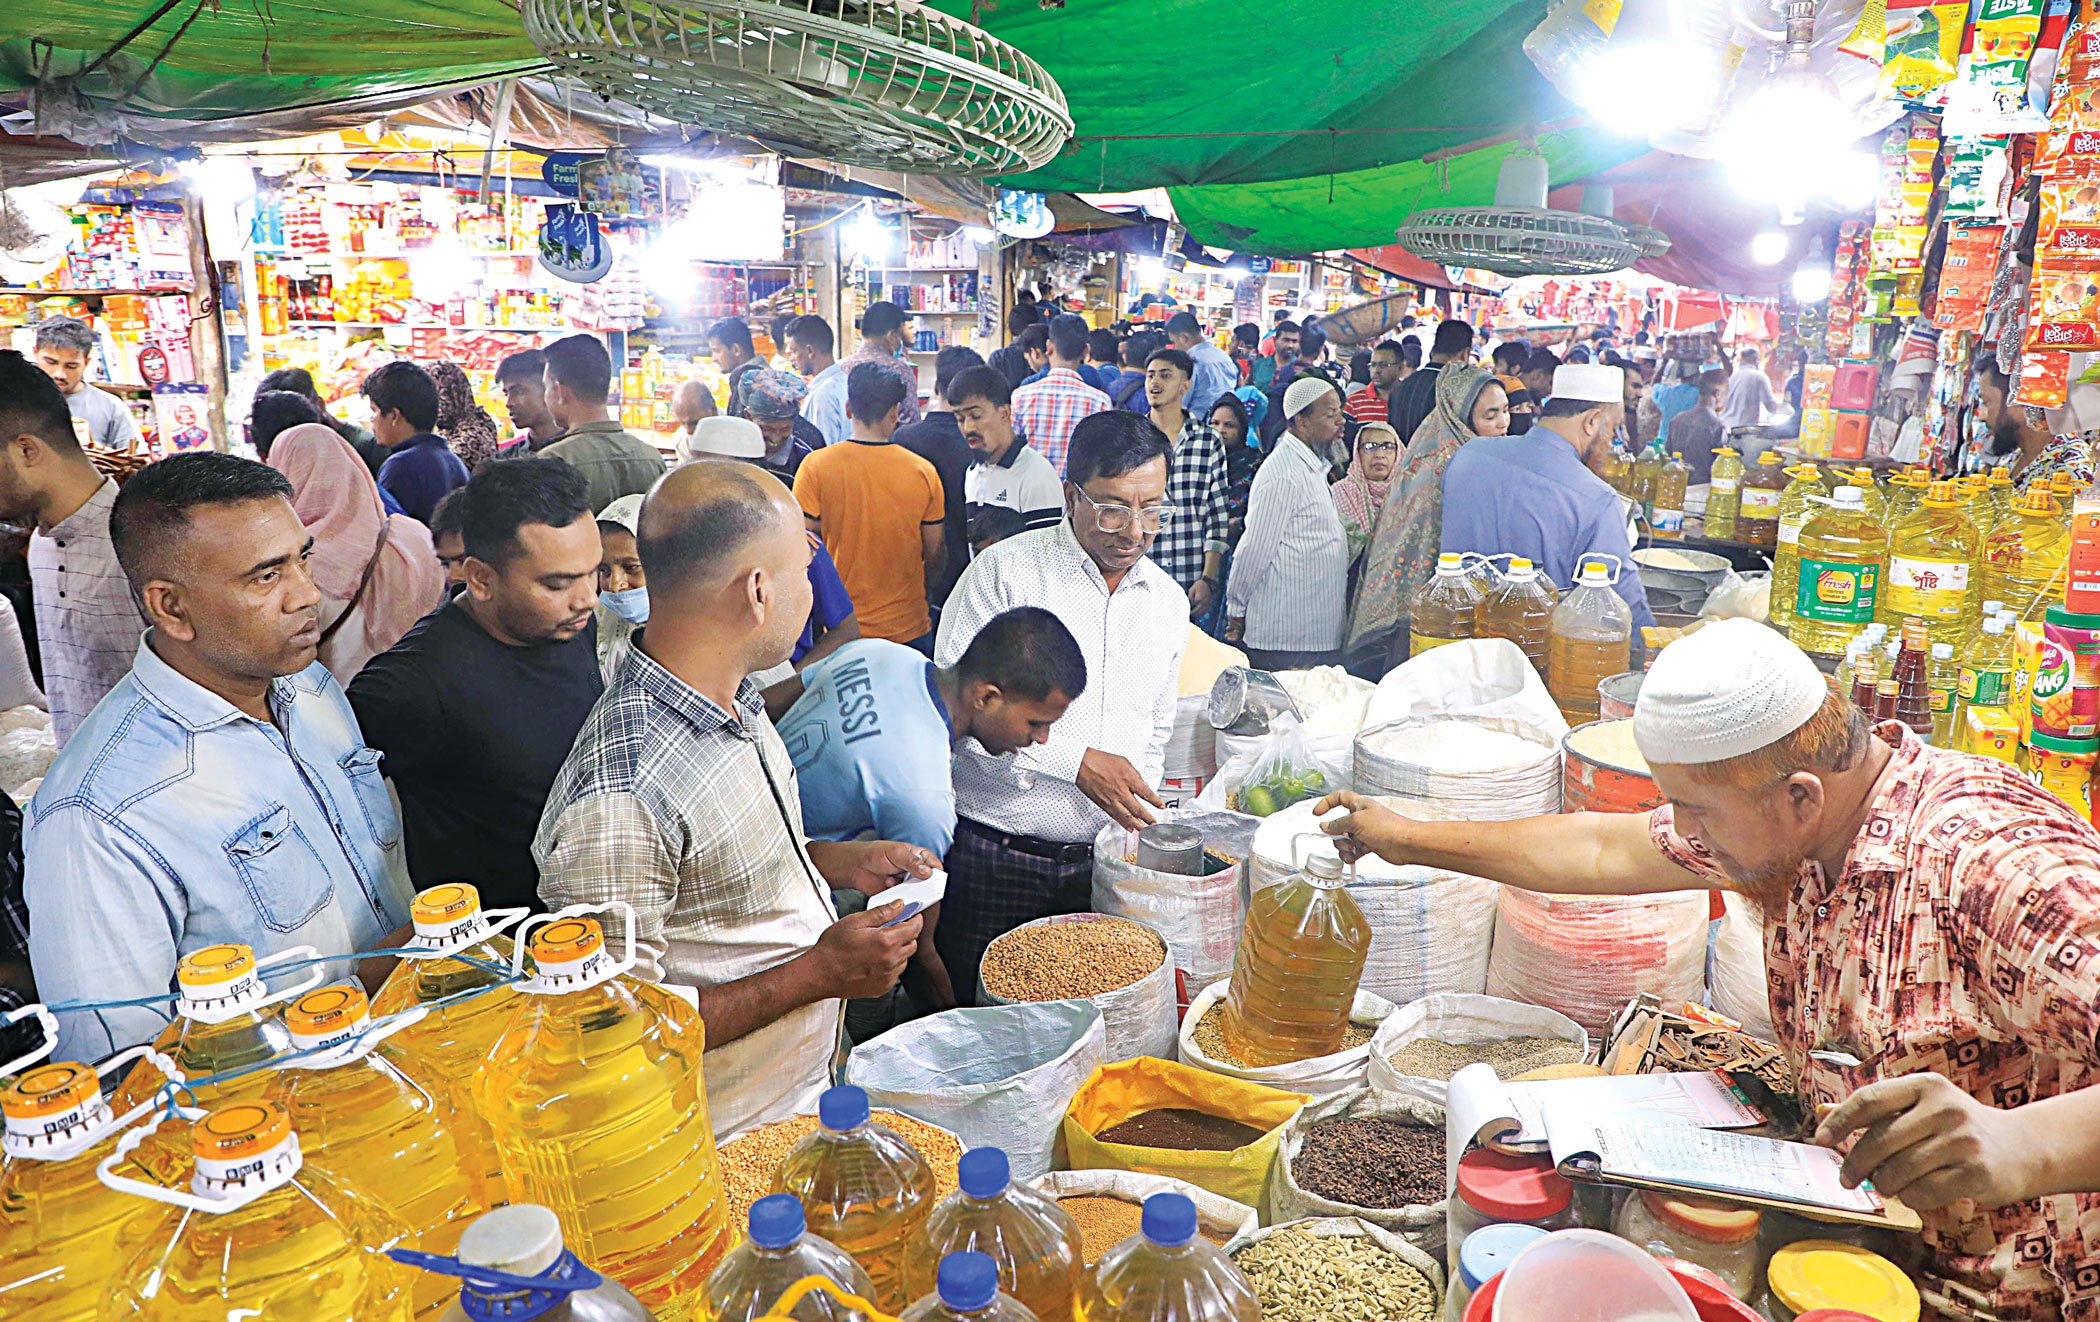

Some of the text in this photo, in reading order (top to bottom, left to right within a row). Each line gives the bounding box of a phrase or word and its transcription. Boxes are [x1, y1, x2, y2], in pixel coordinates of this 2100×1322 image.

[1822, 577, 1851, 589] Fresh
[1913, 571, 1939, 590] পুষ্টি
[2033, 669, 2064, 694] TANG
[831, 657, 882, 745] MESSI
